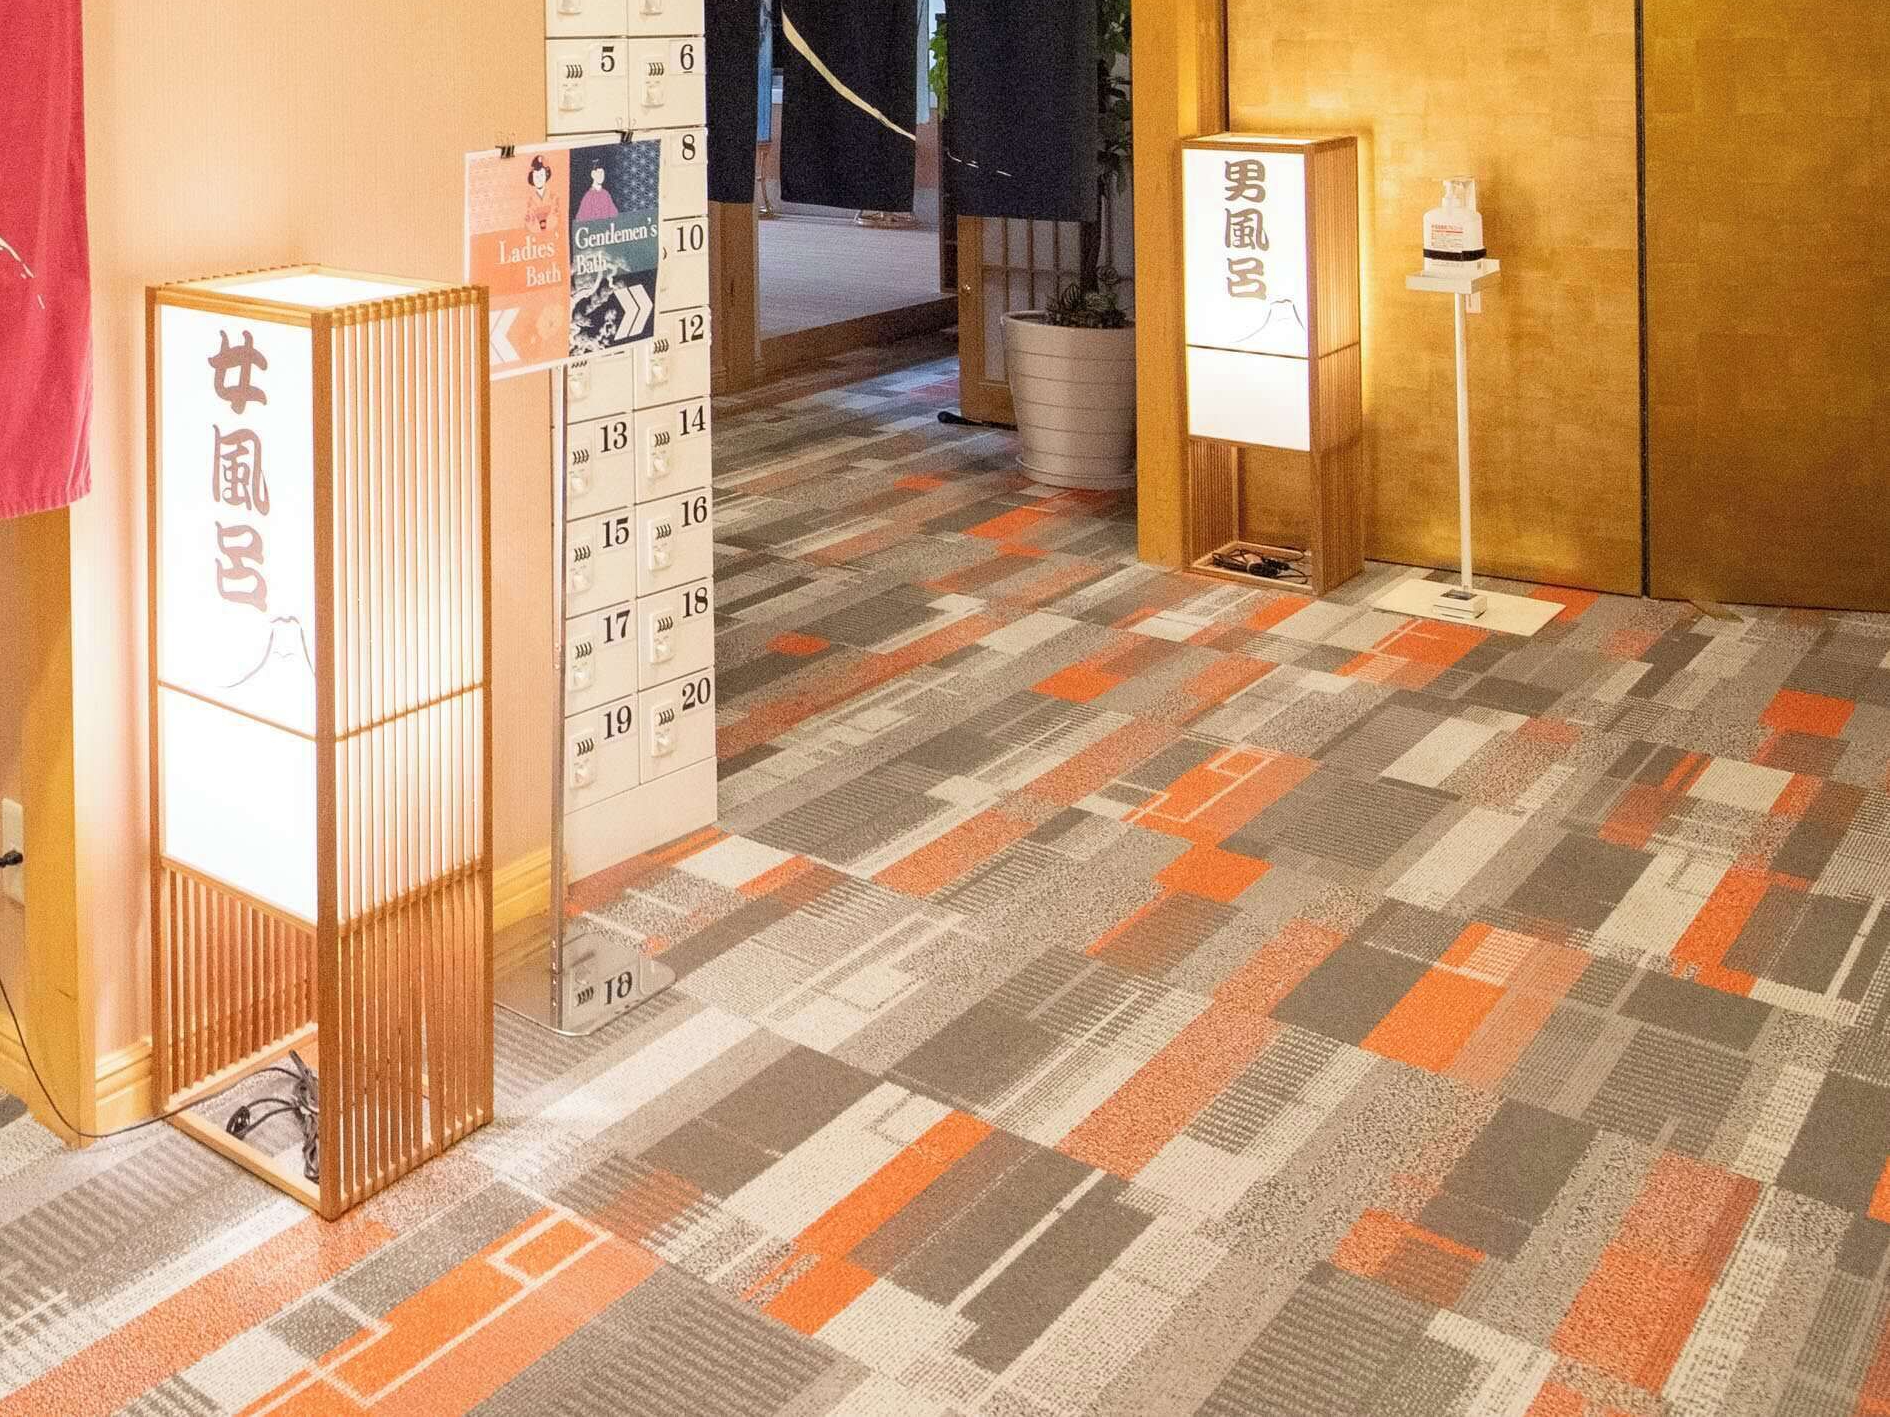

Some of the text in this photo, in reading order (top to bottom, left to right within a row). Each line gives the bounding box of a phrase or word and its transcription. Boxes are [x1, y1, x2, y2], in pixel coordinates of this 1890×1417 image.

[600, 45, 615, 72] 5
[679, 44, 695, 73] 6
[681, 134, 696, 161] 8
[575, 217, 658, 249] Gentlemen's
[676, 224, 704, 253] 10
[1223, 158, 1270, 301] 男風呂
[498, 232, 560, 265] Ladies'
[577, 251, 608, 276] Bath
[525, 262, 562, 288] Bath
[679, 314, 705, 344] 12
[679, 405, 706, 436] 14
[599, 421, 628, 453] 13
[208, 329, 270, 612] 女風呂
[681, 496, 708, 528] 16
[602, 516, 630, 549] 15
[682, 586, 709, 619] 18
[603, 609, 631, 644] 17
[681, 677, 711, 712] 20
[603, 705, 632, 740] 19
